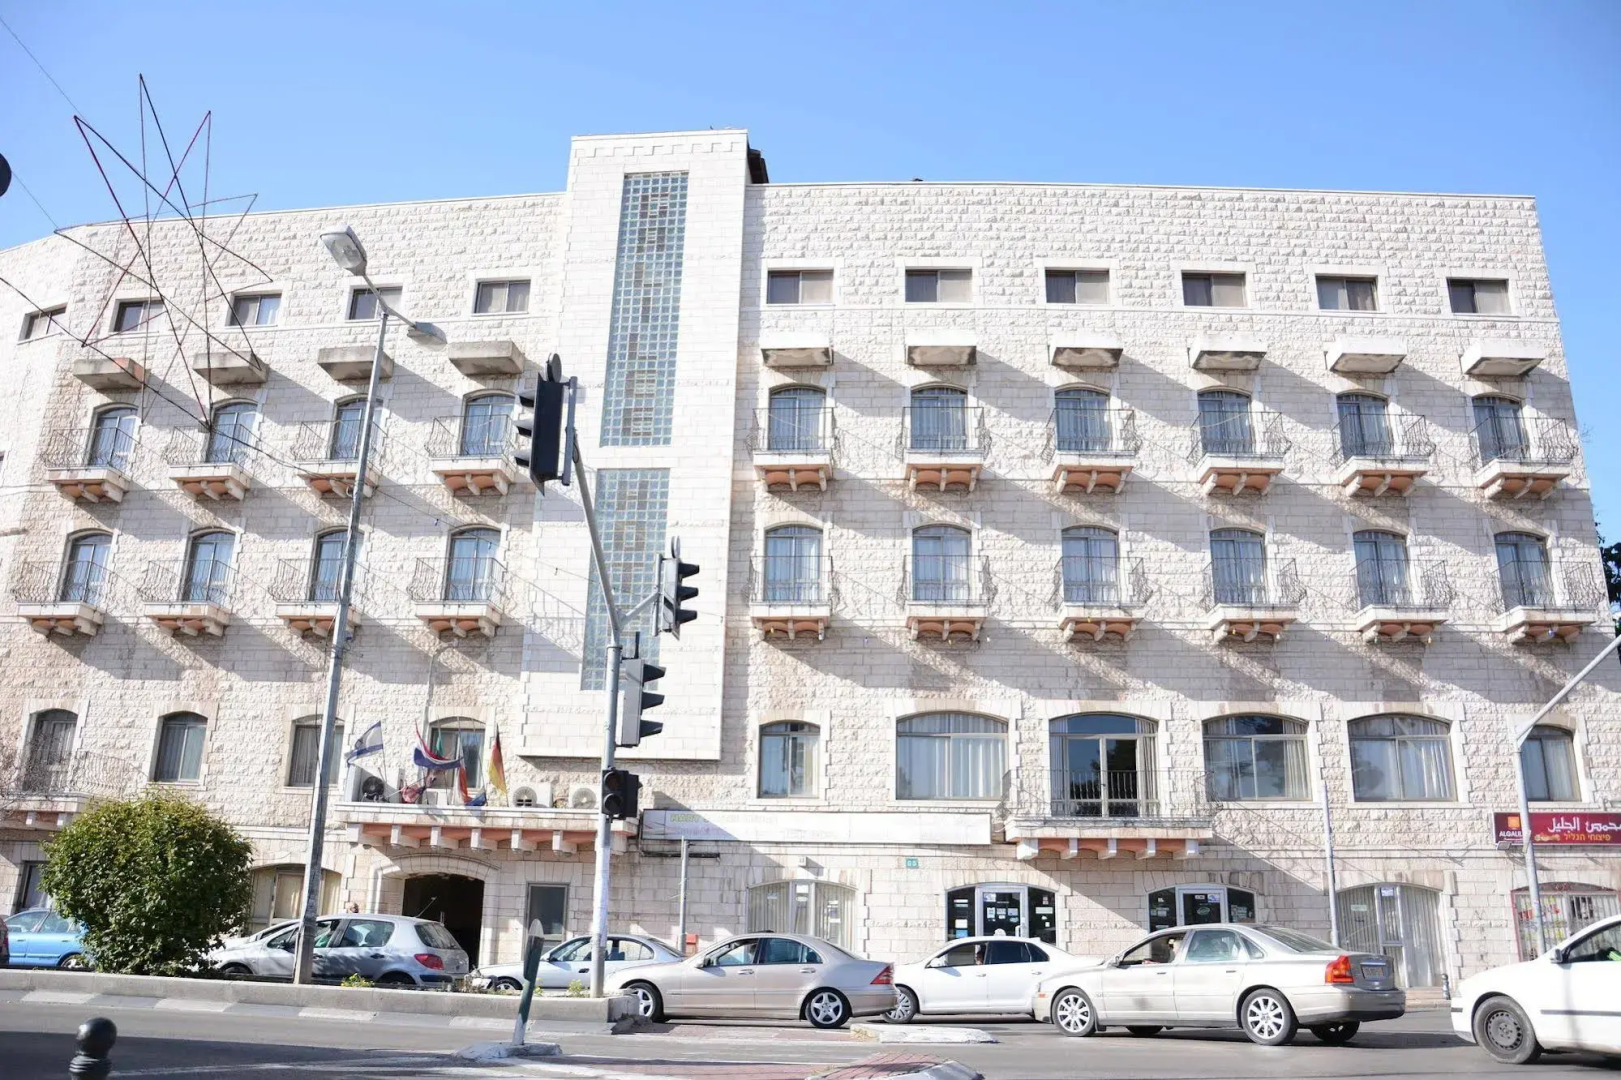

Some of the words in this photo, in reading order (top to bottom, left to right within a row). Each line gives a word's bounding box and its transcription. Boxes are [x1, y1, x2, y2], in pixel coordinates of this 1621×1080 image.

[1547, 816, 1580, 834] الجليل
[1585, 821, 1621, 833] حمص
[1563, 832, 1586, 841] הגליל
